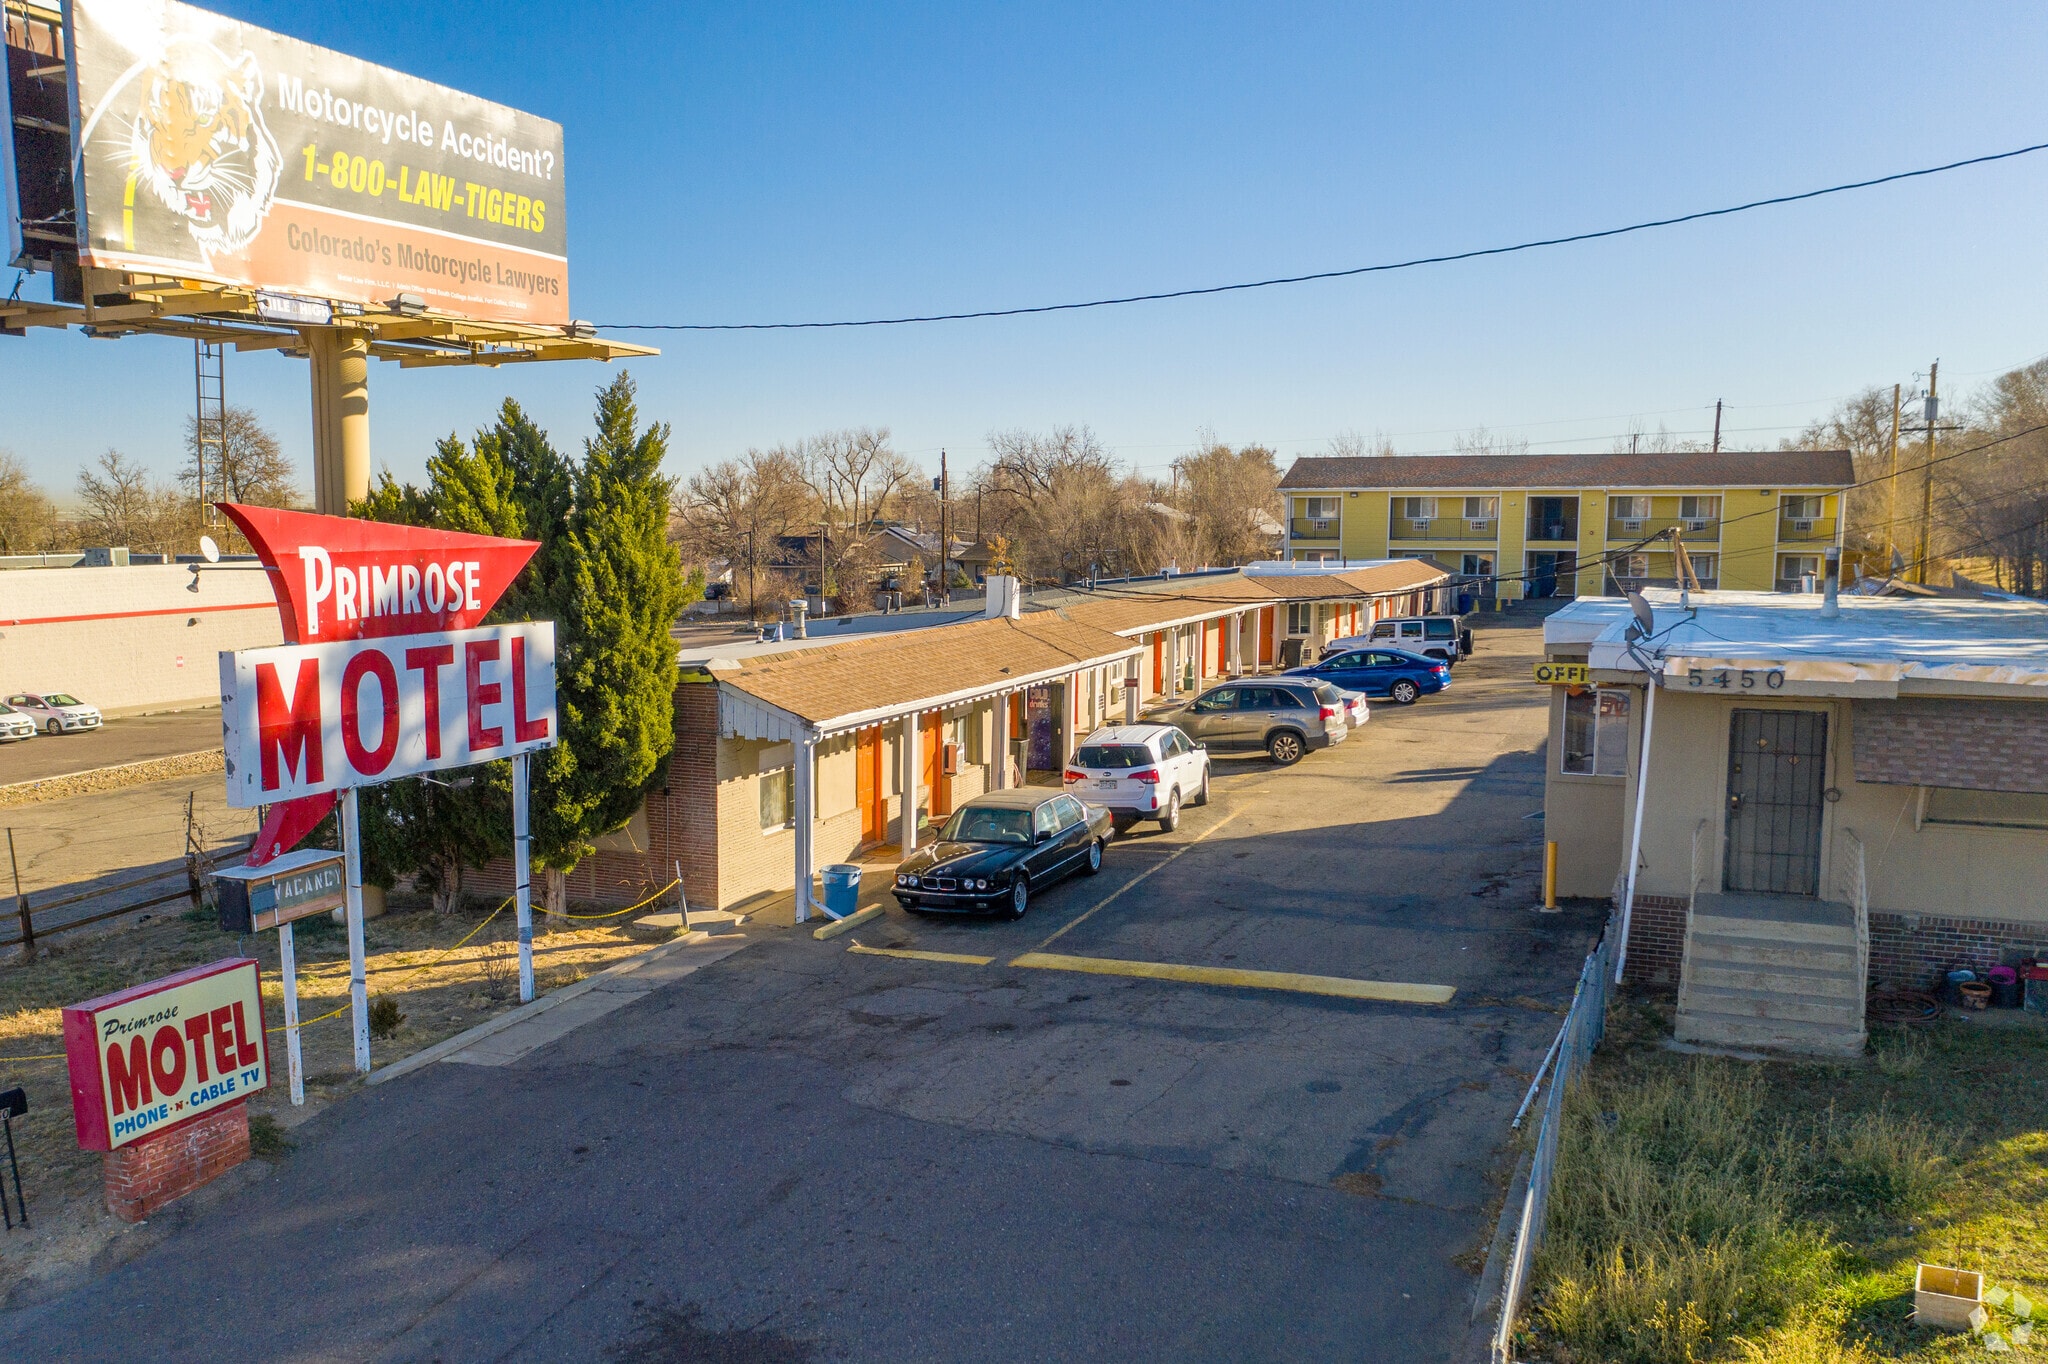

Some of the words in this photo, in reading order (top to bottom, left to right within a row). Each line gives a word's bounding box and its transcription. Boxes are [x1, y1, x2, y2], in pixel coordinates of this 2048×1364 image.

[278, 72, 433, 146] Motorcycle
[441, 120, 555, 180] Accident?
[302, 143, 545, 233] 1-800-LAW-TIGERS
[287, 222, 391, 266] Colorado's
[397, 242, 491, 284] Motorcycle
[496, 261, 559, 296] Lawyers
[299, 546, 481, 635] PRIMROSE
[1537, 666, 1585, 681] OFFI
[1689, 667, 1784, 689] 5450
[256, 636, 549, 792] MOTEL
[275, 867, 341, 900] VACANCY
[103, 1005, 179, 1041] Primrose
[107, 1001, 258, 1116] MOTEL
[114, 1103, 169, 1137] PHONE
[190, 1077, 235, 1106] CABLE
[241, 1068, 259, 1086] TV
